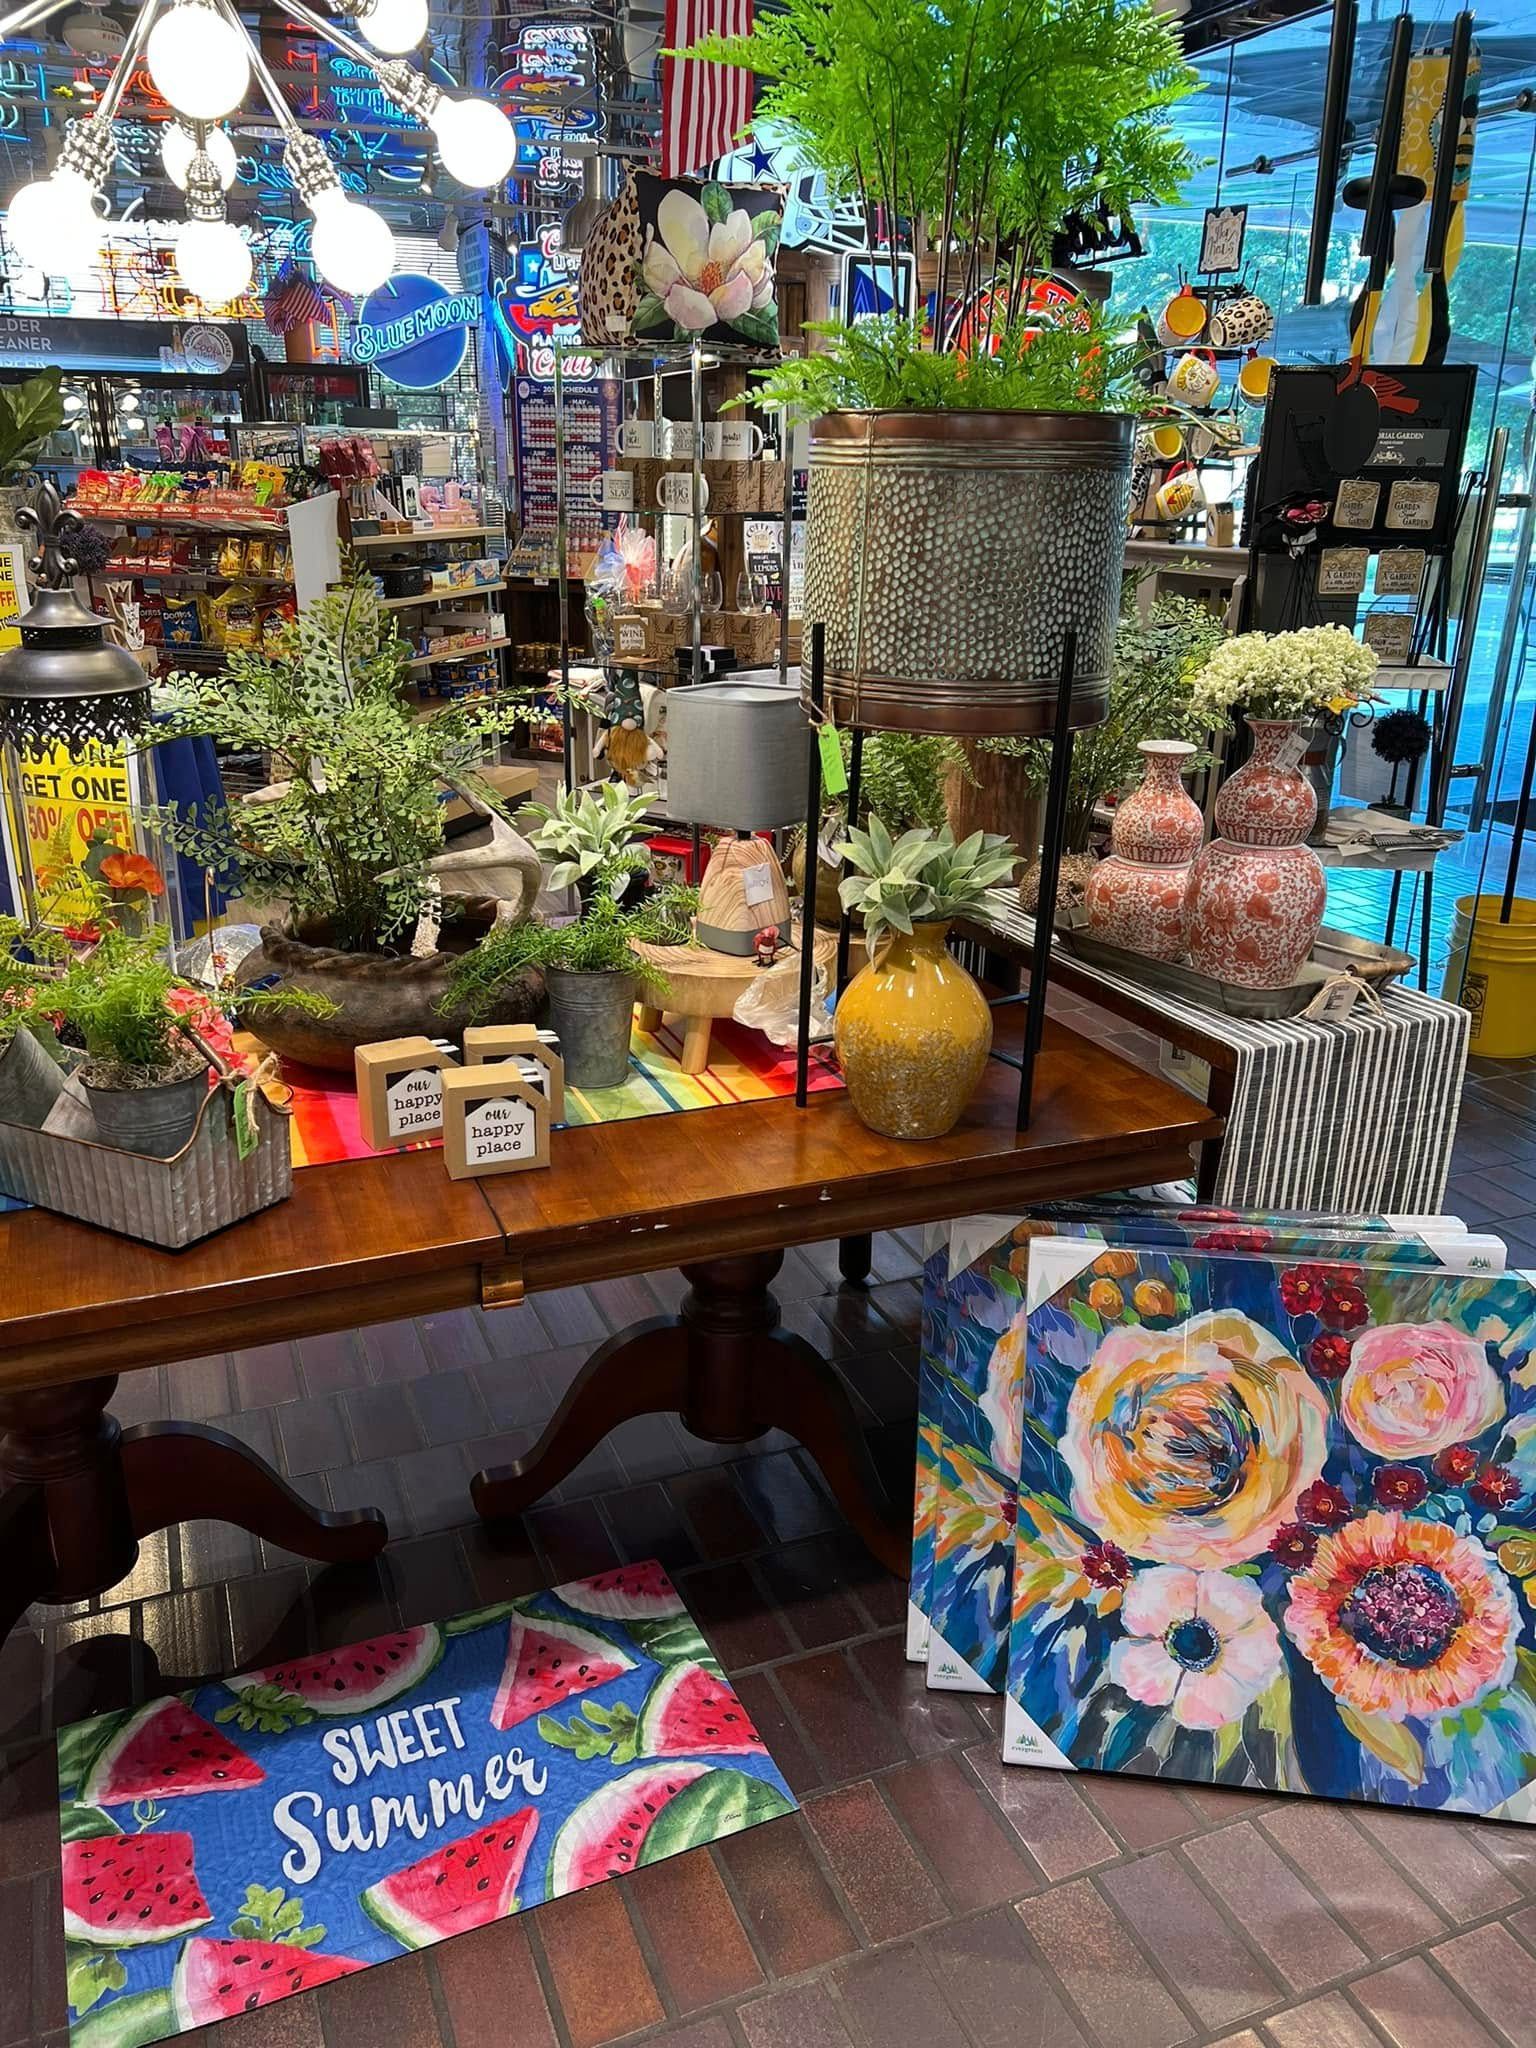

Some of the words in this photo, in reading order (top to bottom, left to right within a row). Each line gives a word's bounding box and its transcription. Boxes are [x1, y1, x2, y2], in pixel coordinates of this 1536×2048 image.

[553, 256, 581, 271] LIGH
[352, 316, 417, 364] BLUE
[416, 295, 480, 336] MOON
[532, 334, 582, 346] PLAYING
[1396, 431, 1424, 440] GARDEN
[1394, 501, 1420, 511] GARDEN
[1402, 517, 1429, 527] GARDEN
[22, 773, 61, 798] GET
[71, 776, 128, 802] ONE
[406, 1079, 432, 1092] our
[393, 1092, 443, 1111] happy
[399, 1109, 441, 1129] place
[485, 1108, 511, 1121] our
[472, 1121, 525, 1139] happy
[476, 1139, 522, 1158] place
[322, 1696, 465, 1788] SWEET
[272, 1744, 548, 1884] Summer
